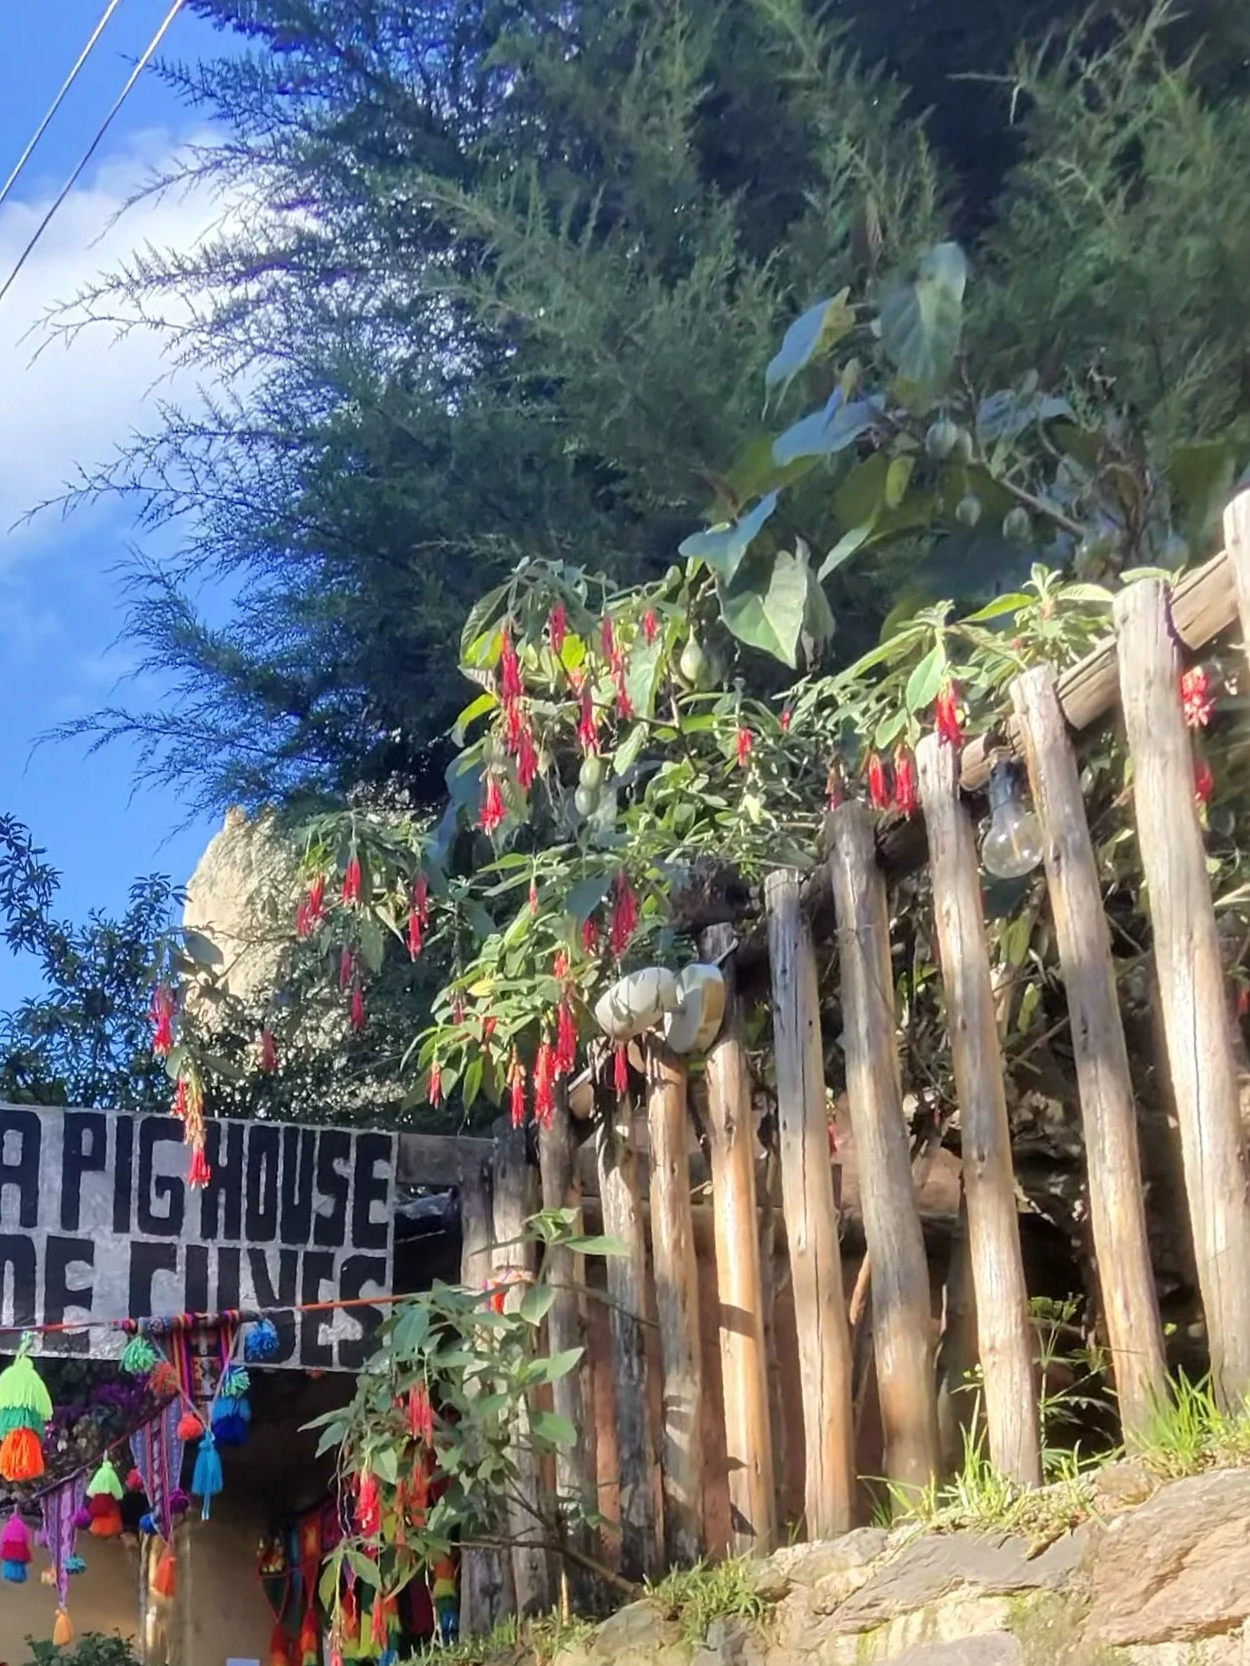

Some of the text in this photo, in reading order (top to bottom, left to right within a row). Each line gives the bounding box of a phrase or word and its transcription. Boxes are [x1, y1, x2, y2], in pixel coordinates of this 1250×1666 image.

[61, 1111, 187, 1238] PIG
[200, 1119, 394, 1250] HOUSE
[129, 1241, 389, 1369] CUYES
